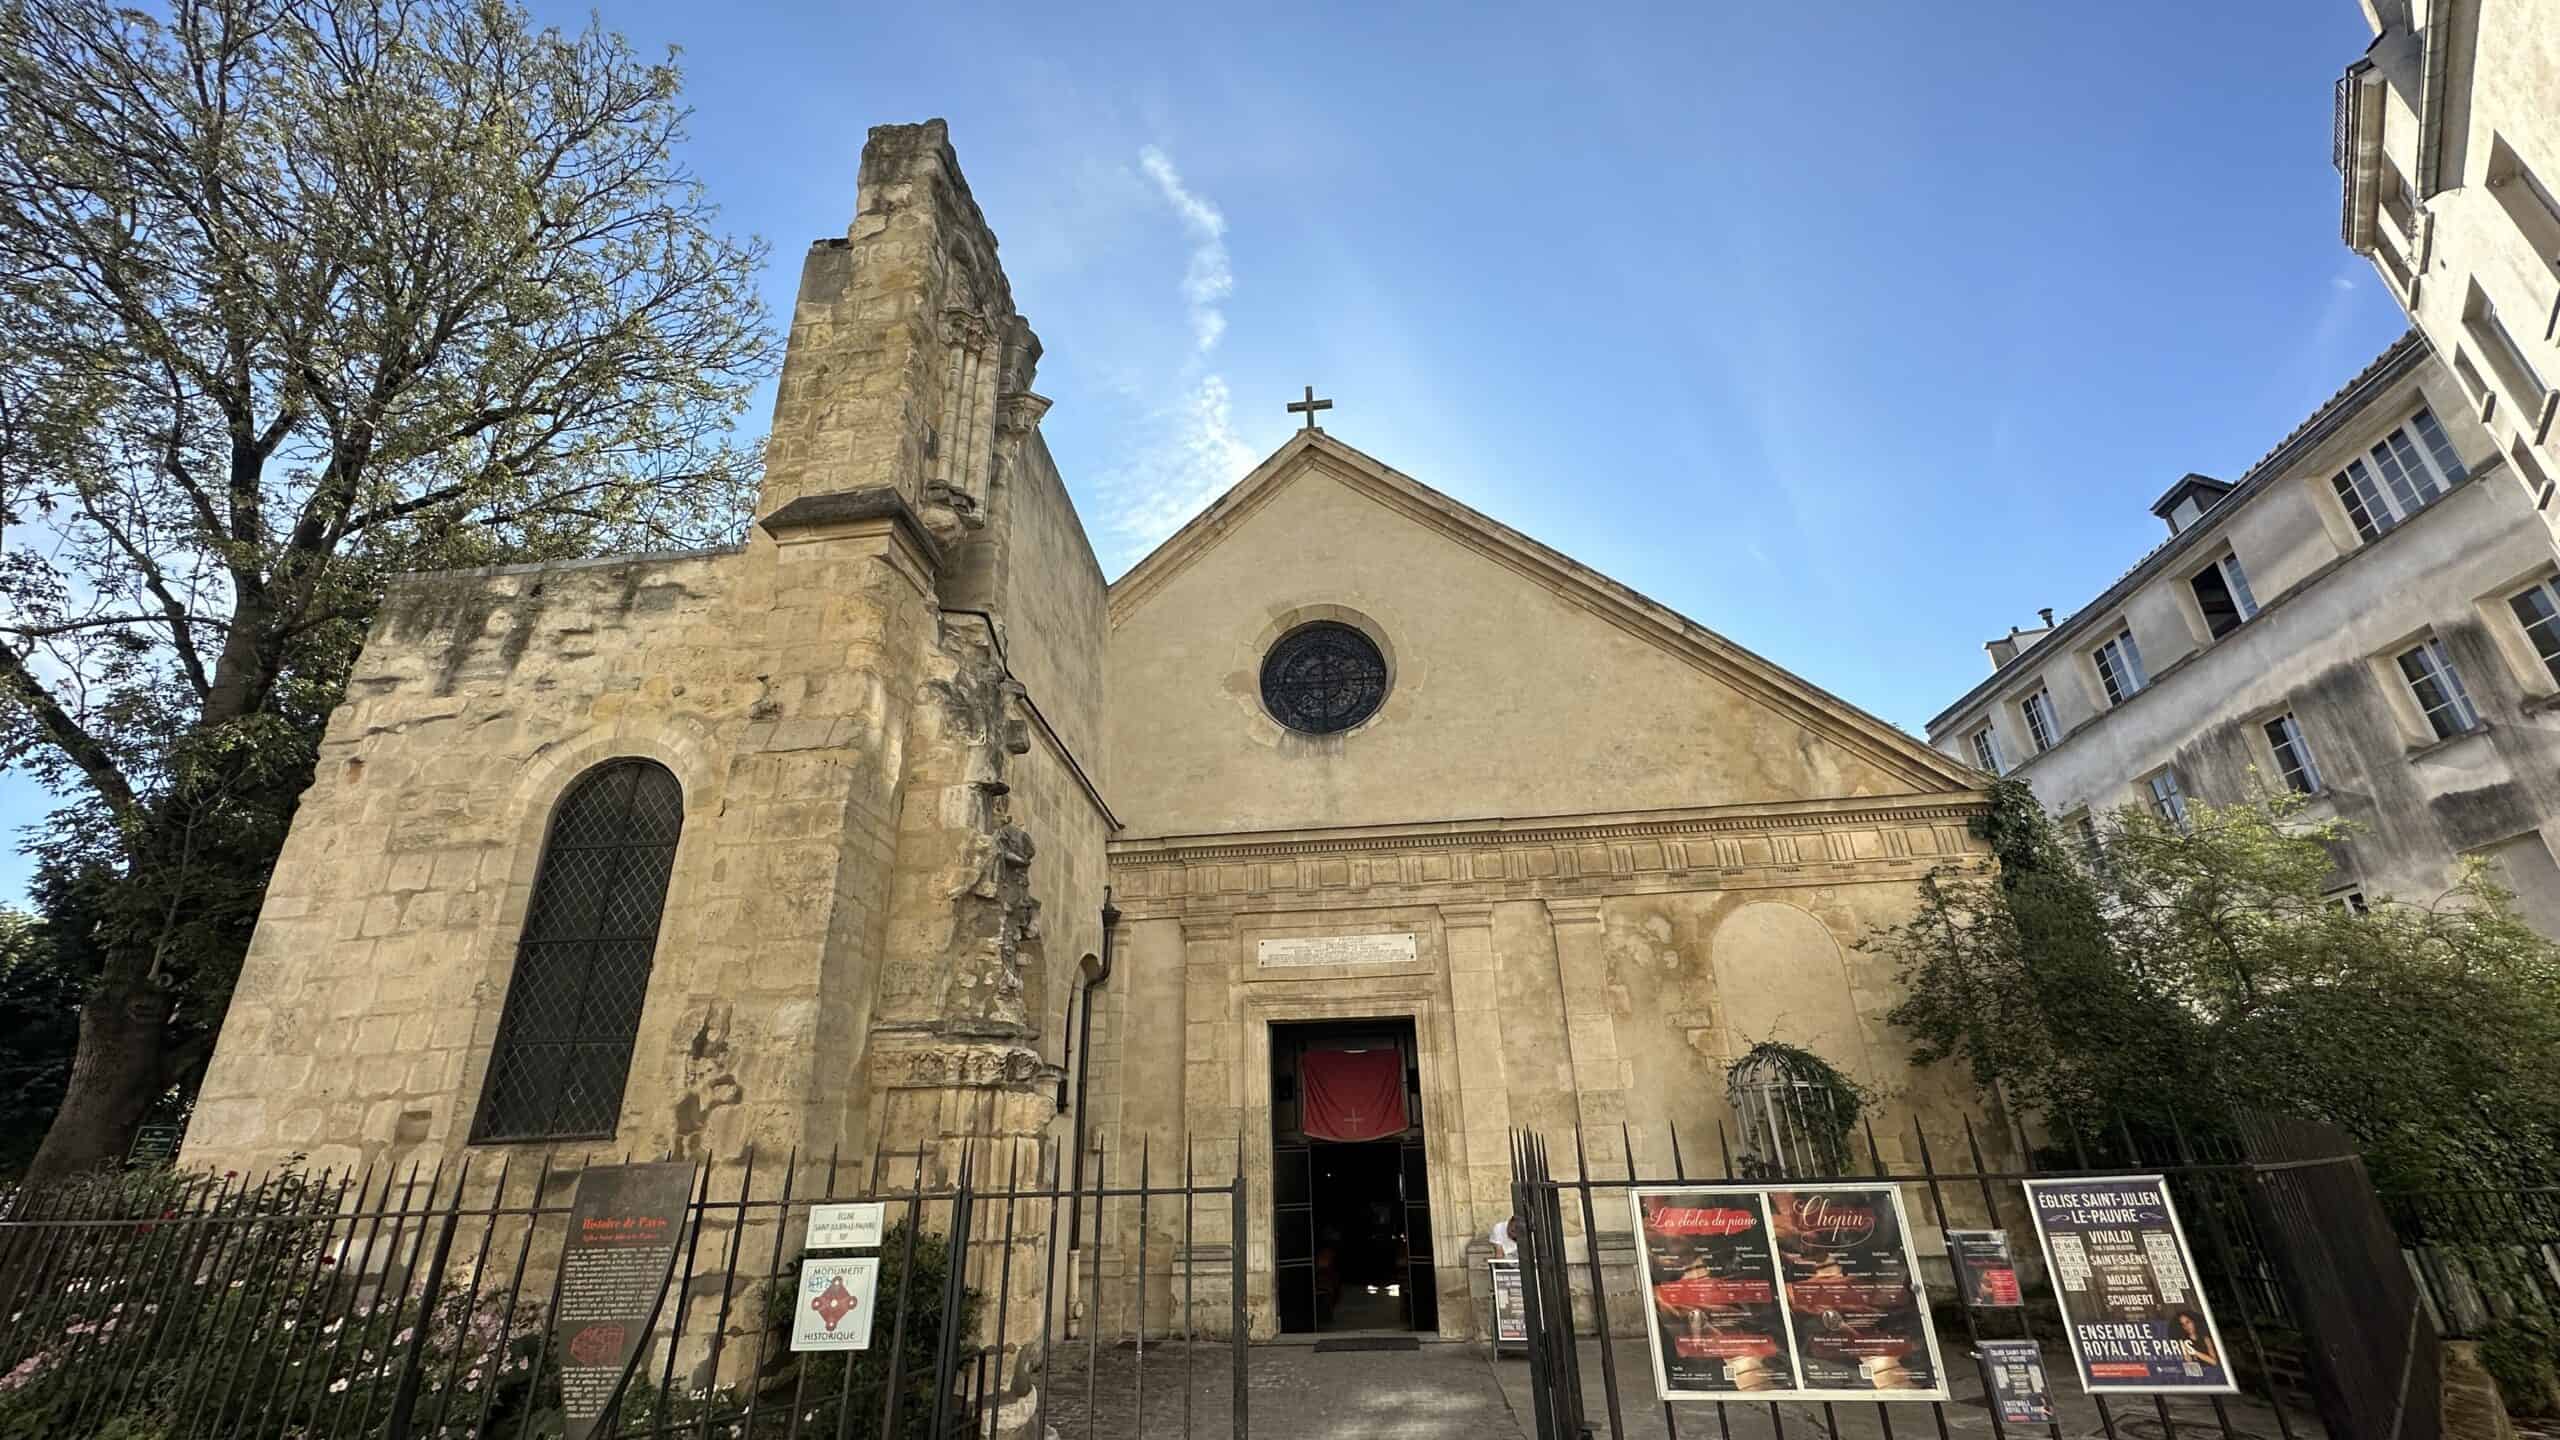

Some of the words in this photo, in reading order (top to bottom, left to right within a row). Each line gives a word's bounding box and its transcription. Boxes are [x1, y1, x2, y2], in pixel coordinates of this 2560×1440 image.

[2038, 1192, 2081, 1208] ÉGLISE
[2081, 1191, 2160, 1207] SAINT-JULIEN
[1650, 1208, 1675, 1228] Les
[1712, 1208, 1726, 1227] du
[1725, 1215, 1758, 1235] piano
[1793, 1195, 1869, 1243] Chopin
[2071, 1209, 2139, 1224] LE-PAUVRE
[2088, 1230, 2134, 1244] VIVALDI
[814, 1267, 864, 1276] MONUMENT
[2106, 1274, 2144, 1286] MOZART
[2107, 1294, 2154, 1306] SCHUBERT
[804, 1331, 856, 1341] HISTORIQUE
[2077, 1323, 2153, 1340] ENSEMBLE
[2083, 1341, 2128, 1358] ROYAL
[2130, 1340, 2151, 1356] DE
[2152, 1339, 2196, 1356] PARIS
